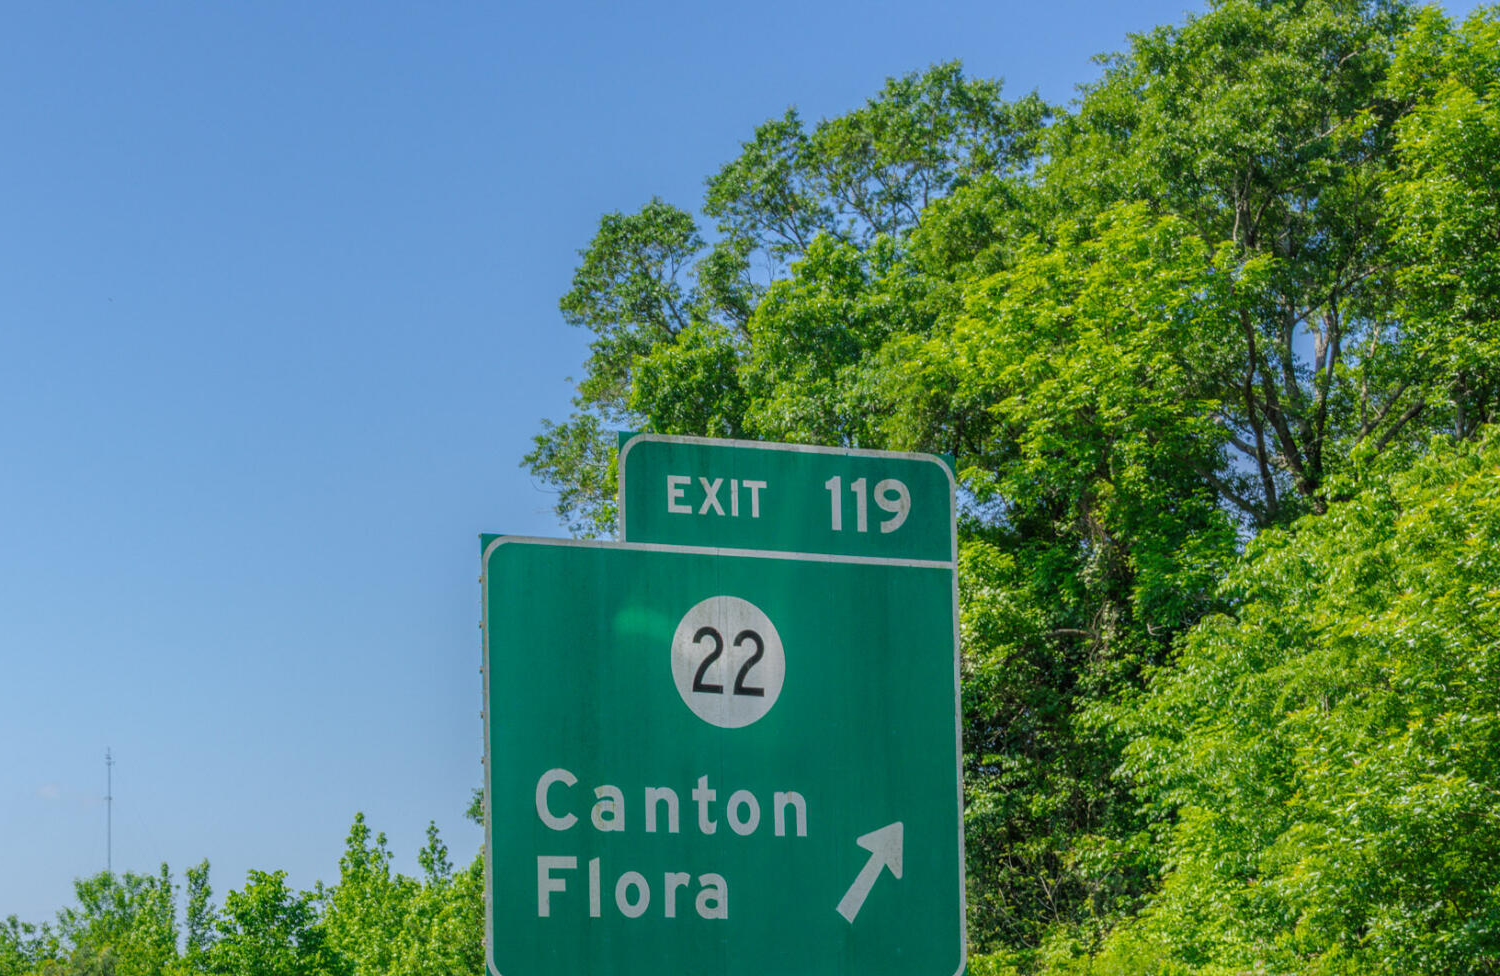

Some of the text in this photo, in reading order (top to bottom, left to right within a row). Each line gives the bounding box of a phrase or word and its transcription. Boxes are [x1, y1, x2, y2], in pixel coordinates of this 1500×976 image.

[666, 475, 912, 534] EXIT 119
[691, 626, 765, 697] 22
[535, 767, 808, 837] Canton
[536, 855, 729, 920] Flora
